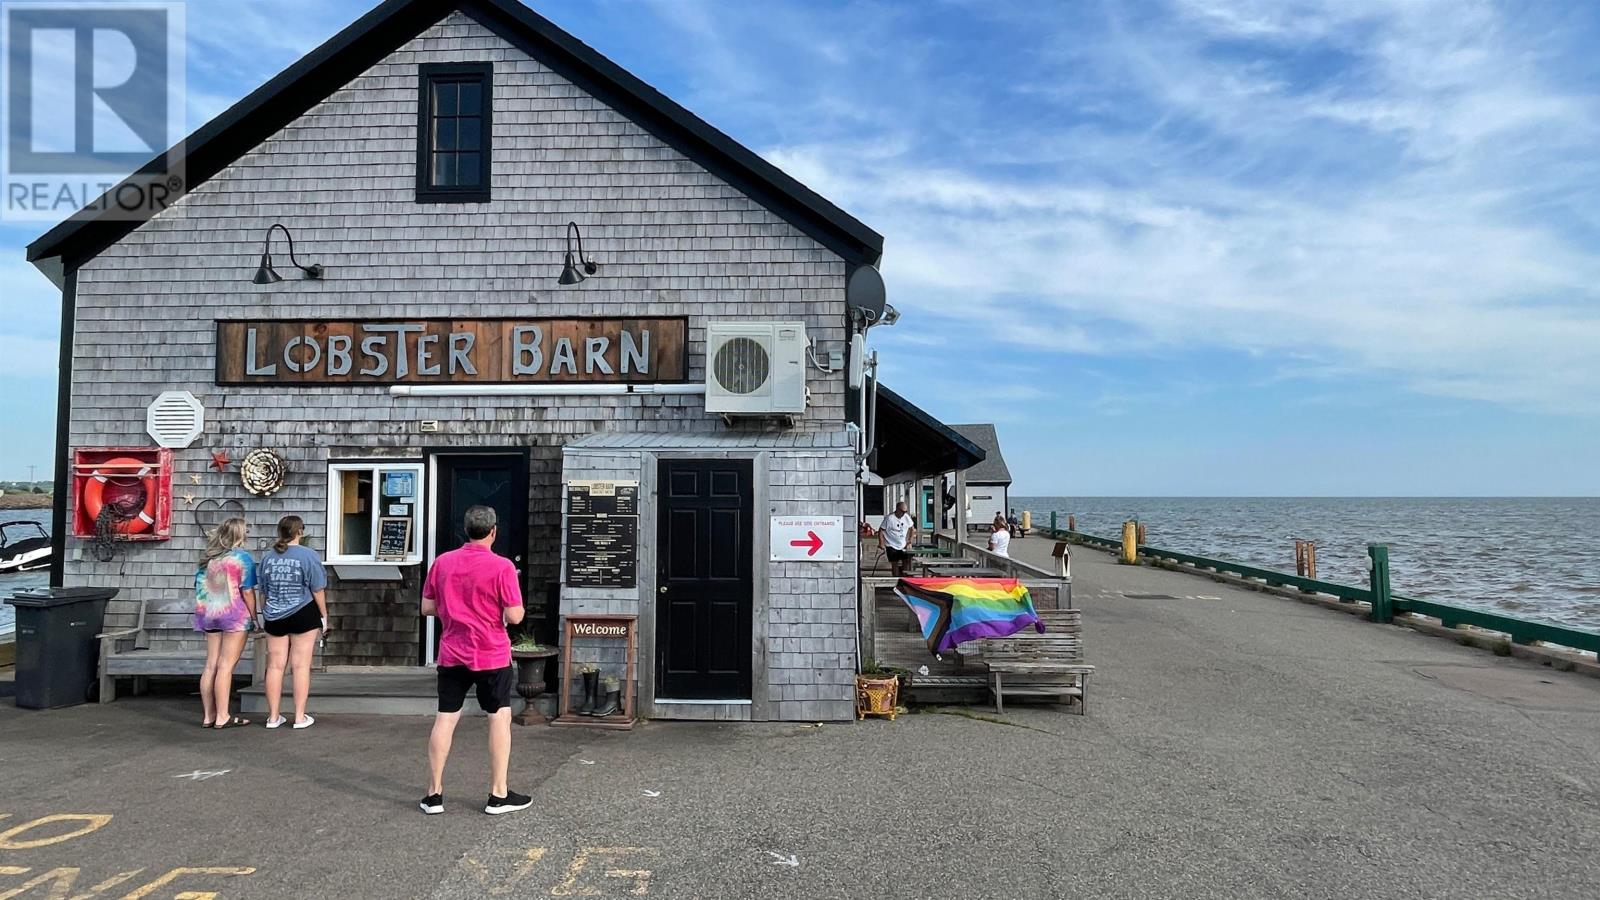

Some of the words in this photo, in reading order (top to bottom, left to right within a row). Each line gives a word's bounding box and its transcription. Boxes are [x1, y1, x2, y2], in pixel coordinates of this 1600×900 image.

[246, 323, 478, 379] LOBSTER
[512, 325, 650, 376] BARN
[267, 558, 301, 567] PLANTS
[271, 565, 291, 573] FOR
[573, 623, 627, 635] Welcome
